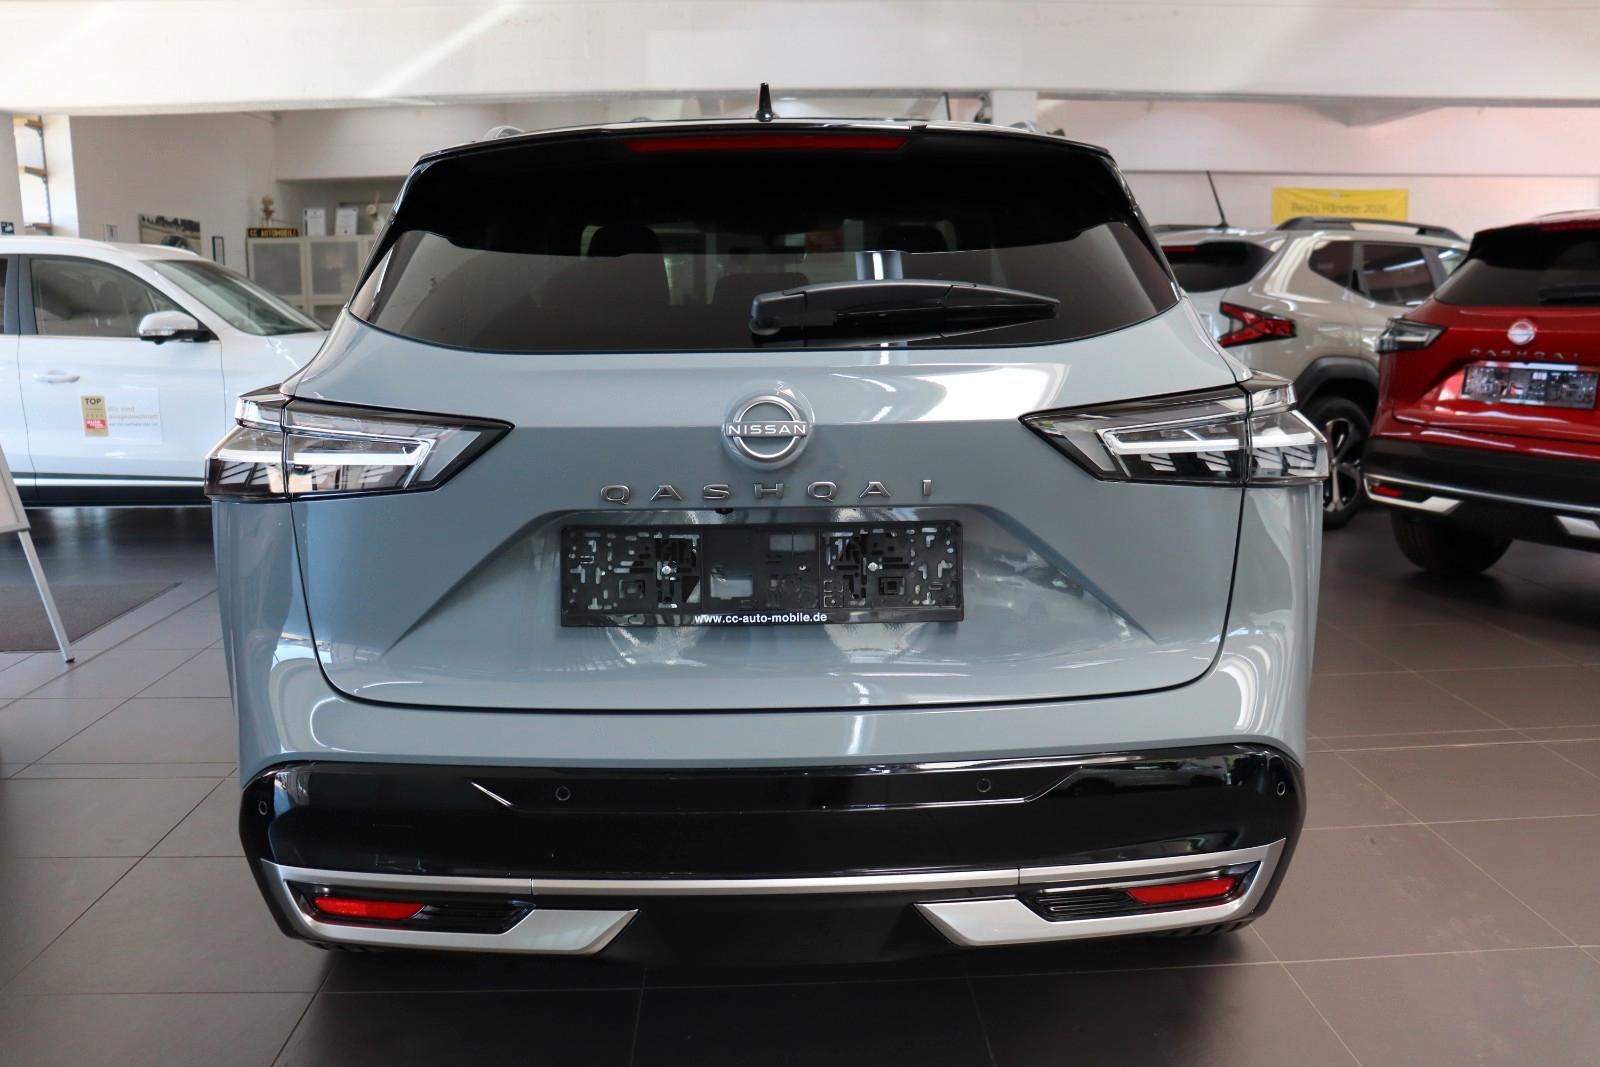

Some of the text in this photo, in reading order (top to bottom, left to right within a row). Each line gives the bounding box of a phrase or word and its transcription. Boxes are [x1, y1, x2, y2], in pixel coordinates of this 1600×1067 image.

[728, 424, 806, 435] NISSAN
[600, 479, 932, 504] QASHQAI
[694, 612, 827, 624] www.cc-auto-mobile.de
